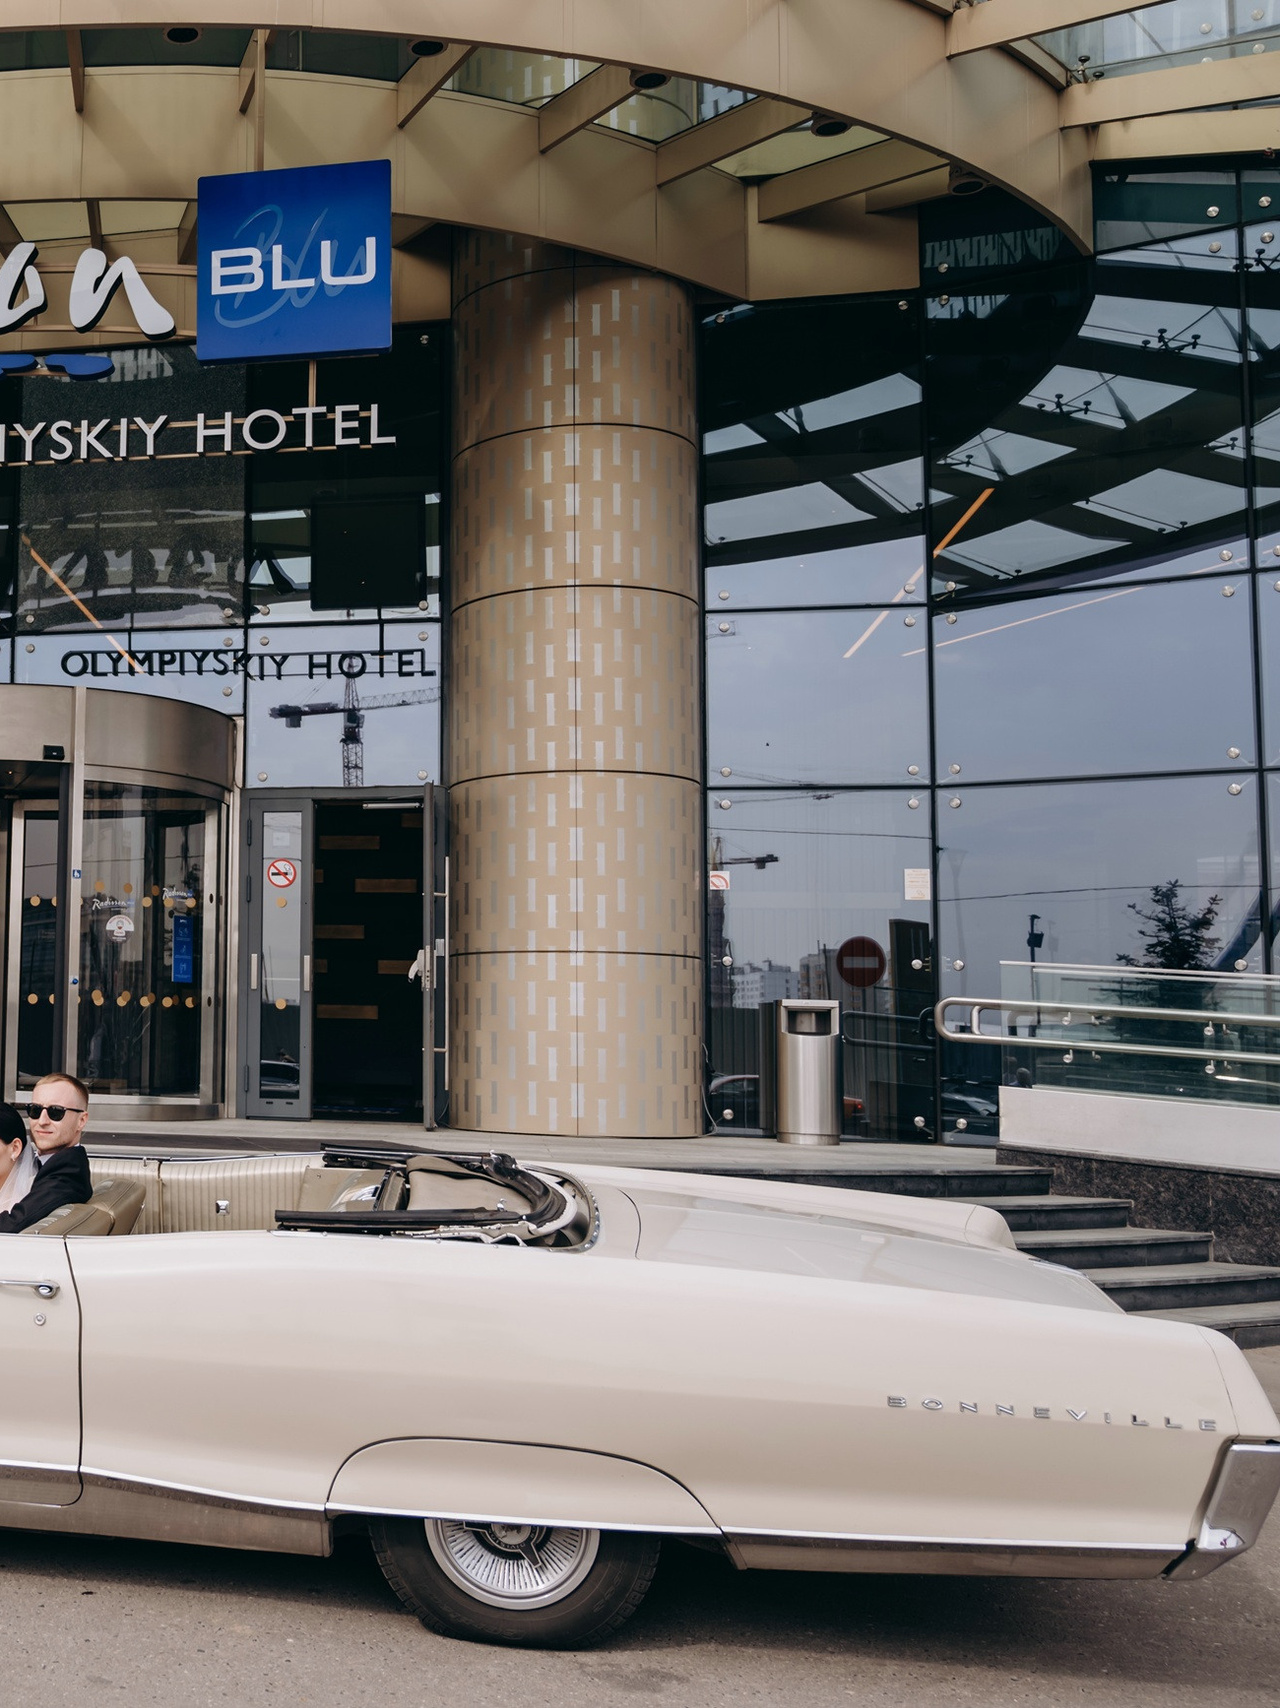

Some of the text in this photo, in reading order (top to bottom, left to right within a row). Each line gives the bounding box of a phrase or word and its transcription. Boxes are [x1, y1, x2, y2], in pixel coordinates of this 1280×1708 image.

[211, 236, 376, 296] BLU
[196, 403, 397, 453] HOTEL
[60, 648, 437, 681] OLYMPIYSKIY HOTEL
[92, 896, 128, 911] Radisson
[886, 1395, 1218, 1432] BONNEVILLE
